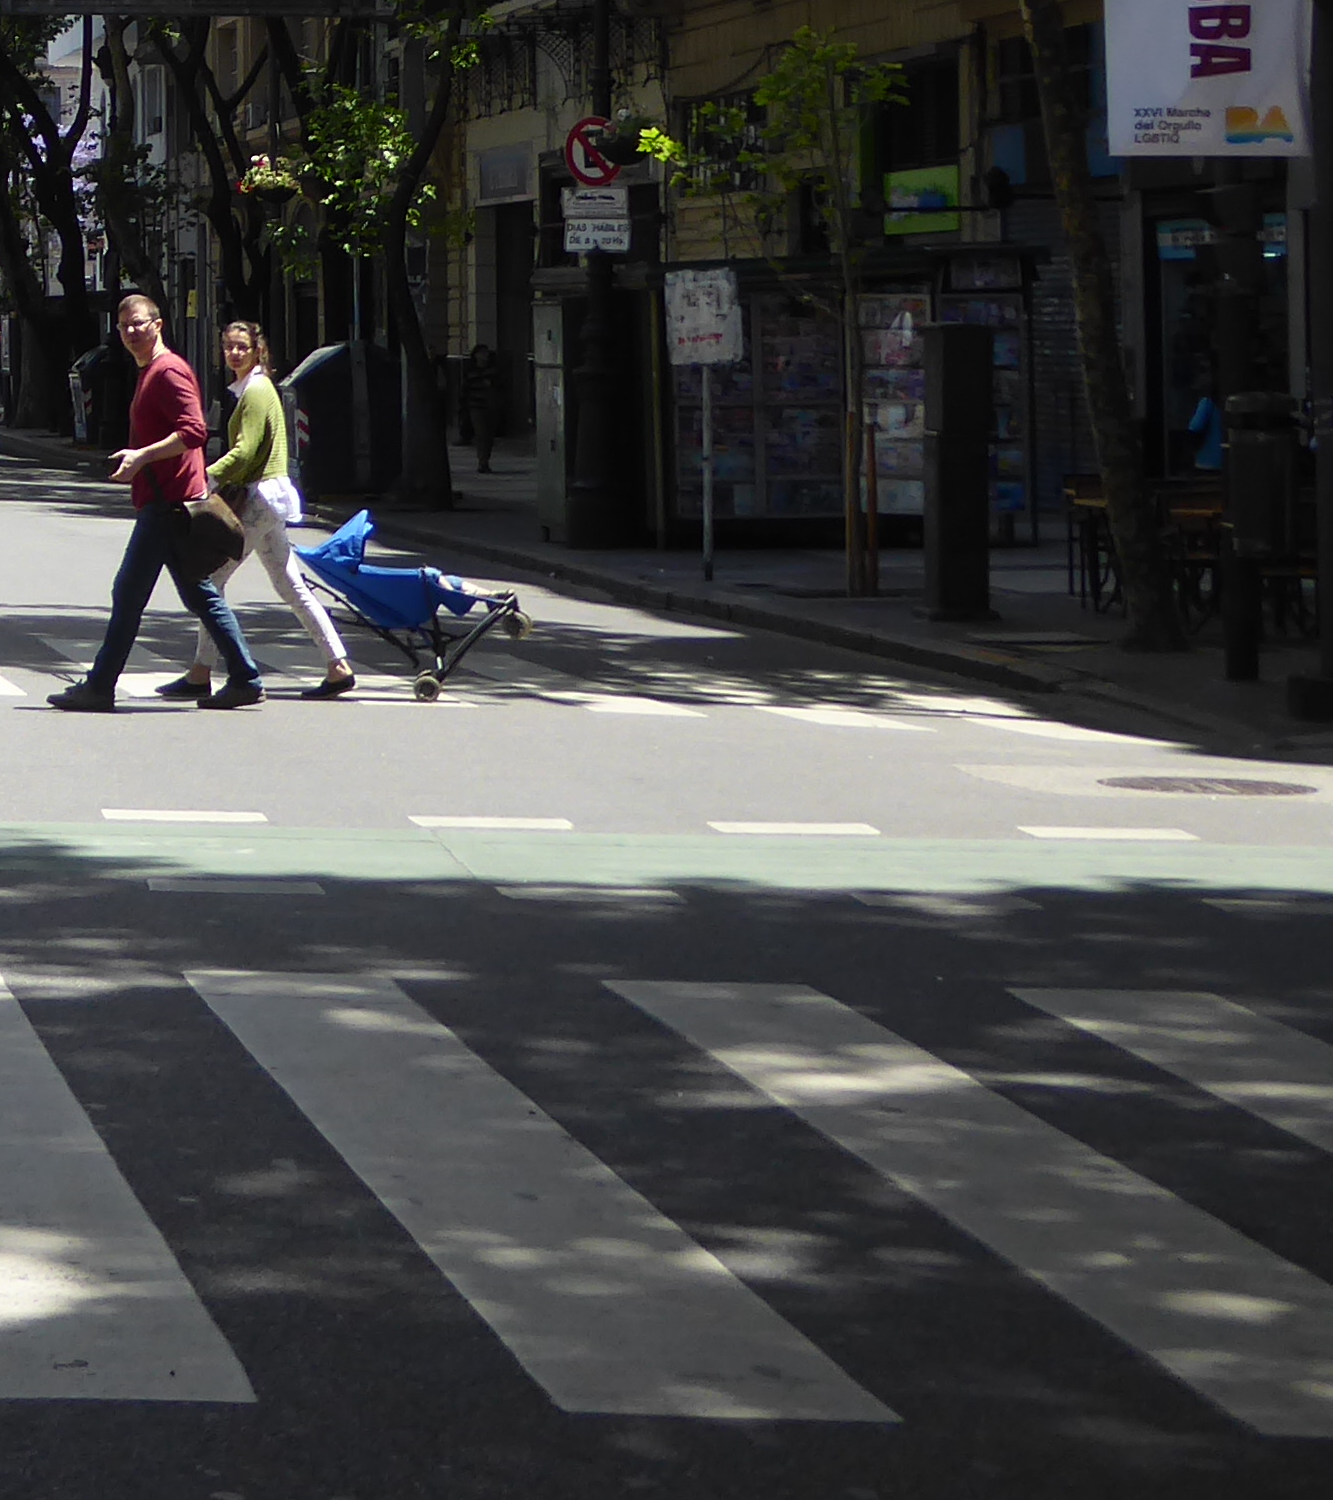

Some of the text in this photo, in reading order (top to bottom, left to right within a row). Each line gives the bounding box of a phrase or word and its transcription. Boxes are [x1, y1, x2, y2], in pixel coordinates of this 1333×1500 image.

[1133, 108, 1163, 118] XXVI
[1134, 120, 1202, 134] del Orgullo
[1225, 105, 1294, 144] BA
